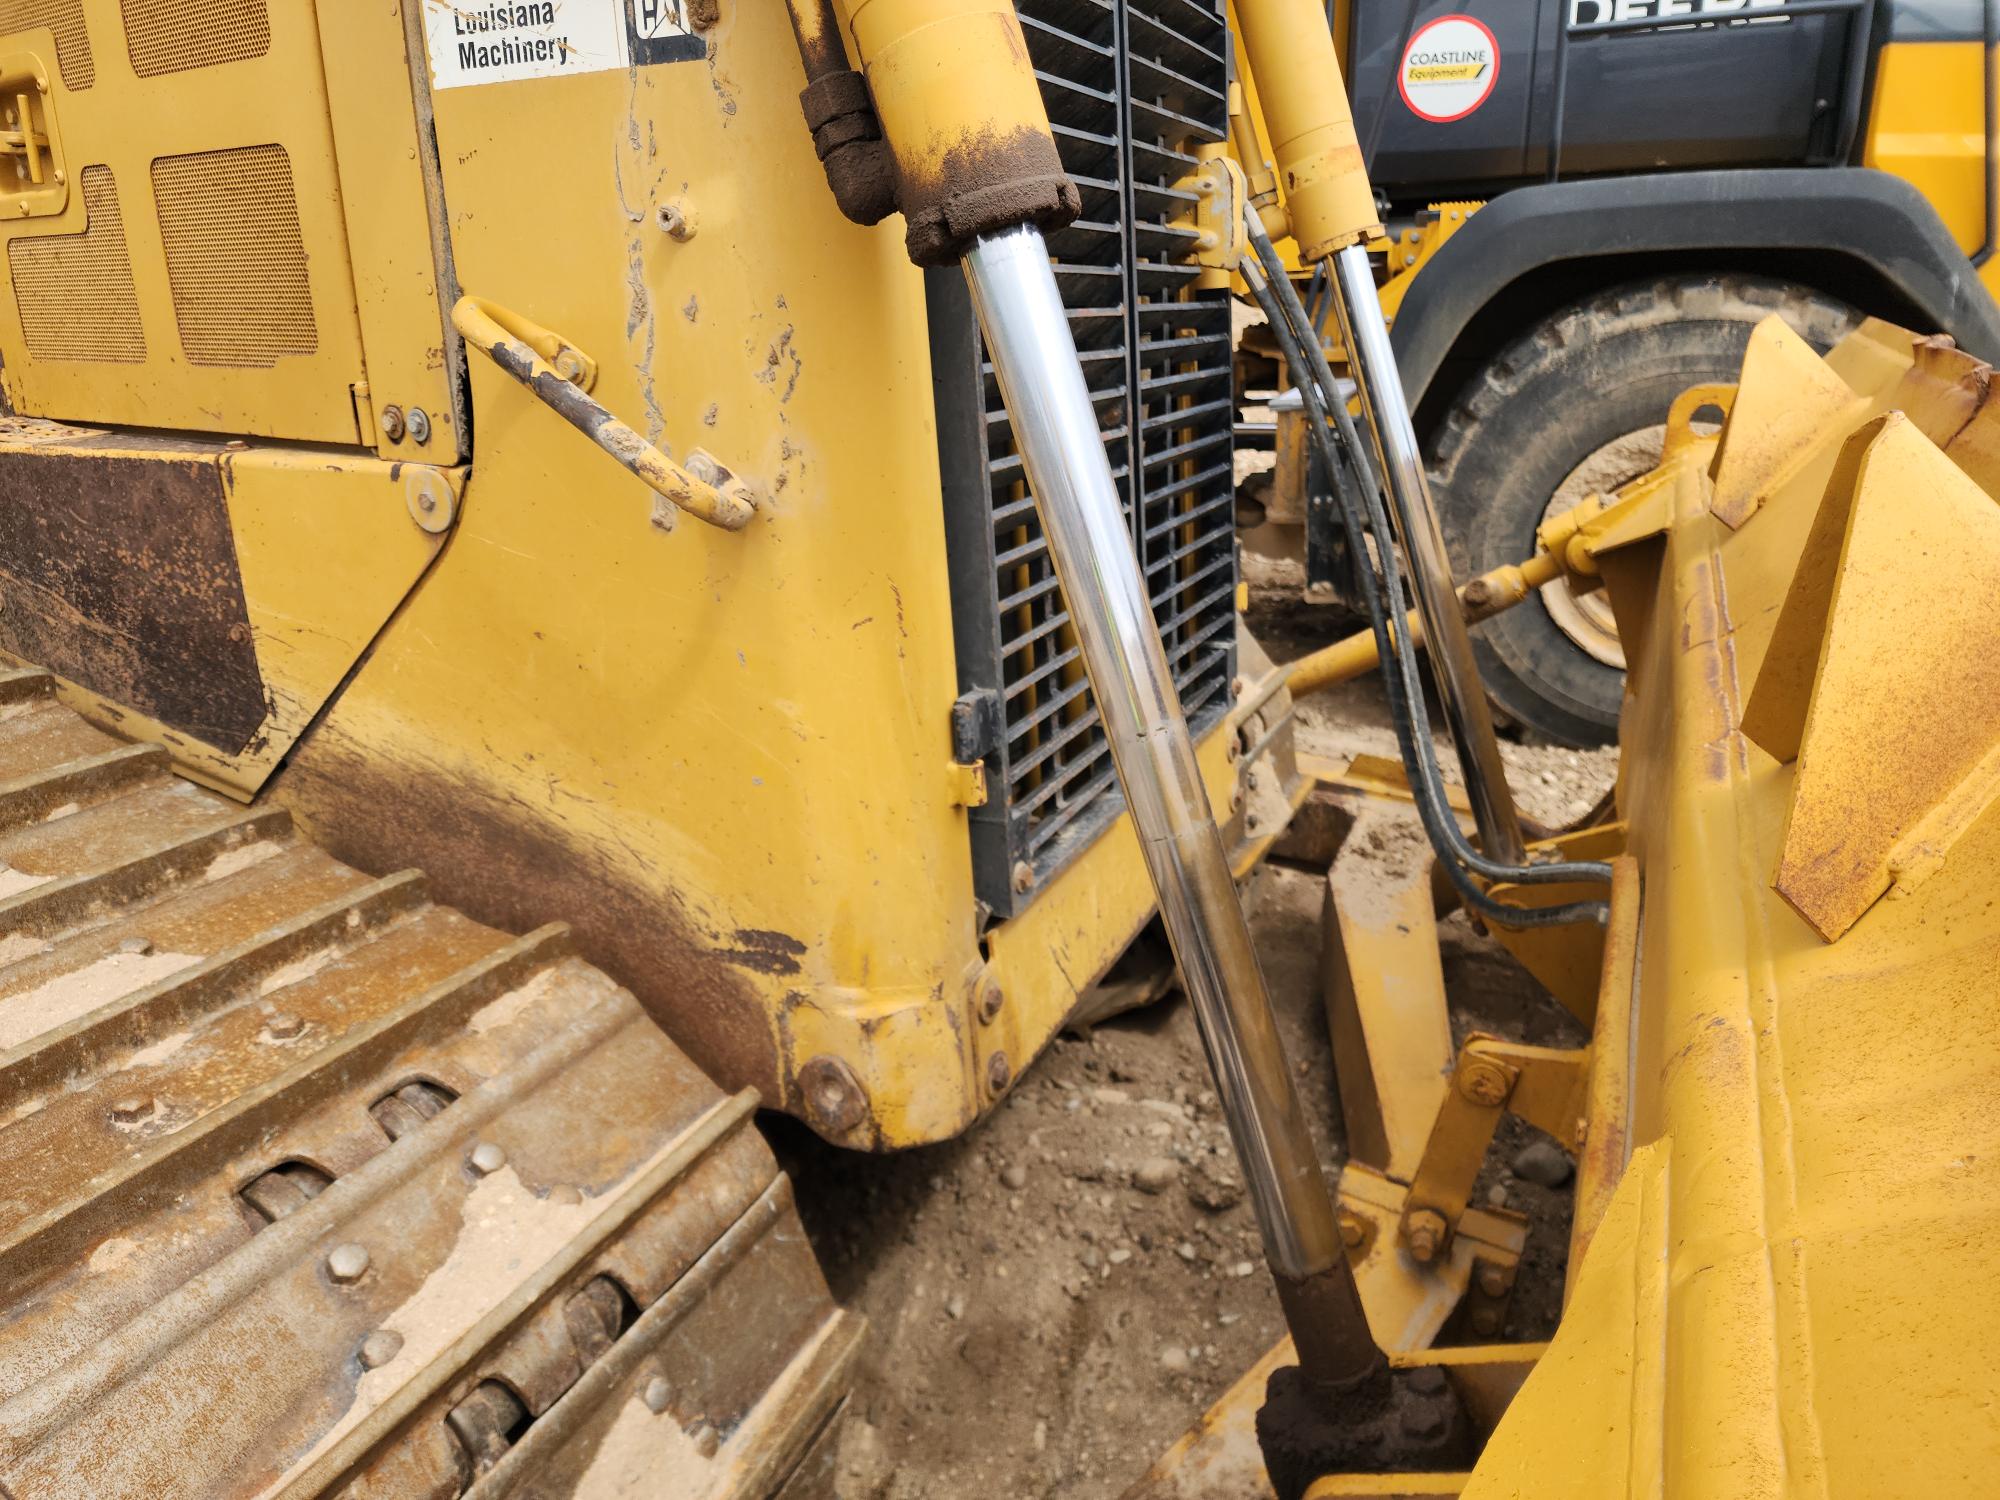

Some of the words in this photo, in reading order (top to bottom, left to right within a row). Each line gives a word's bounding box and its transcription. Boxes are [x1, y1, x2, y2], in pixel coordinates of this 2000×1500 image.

[453, 1, 555, 36] Louisiana
[458, 36, 568, 70] Machinery
[1410, 50, 1487, 65] COASTLINE
[1409, 67, 1468, 80] Equipment
